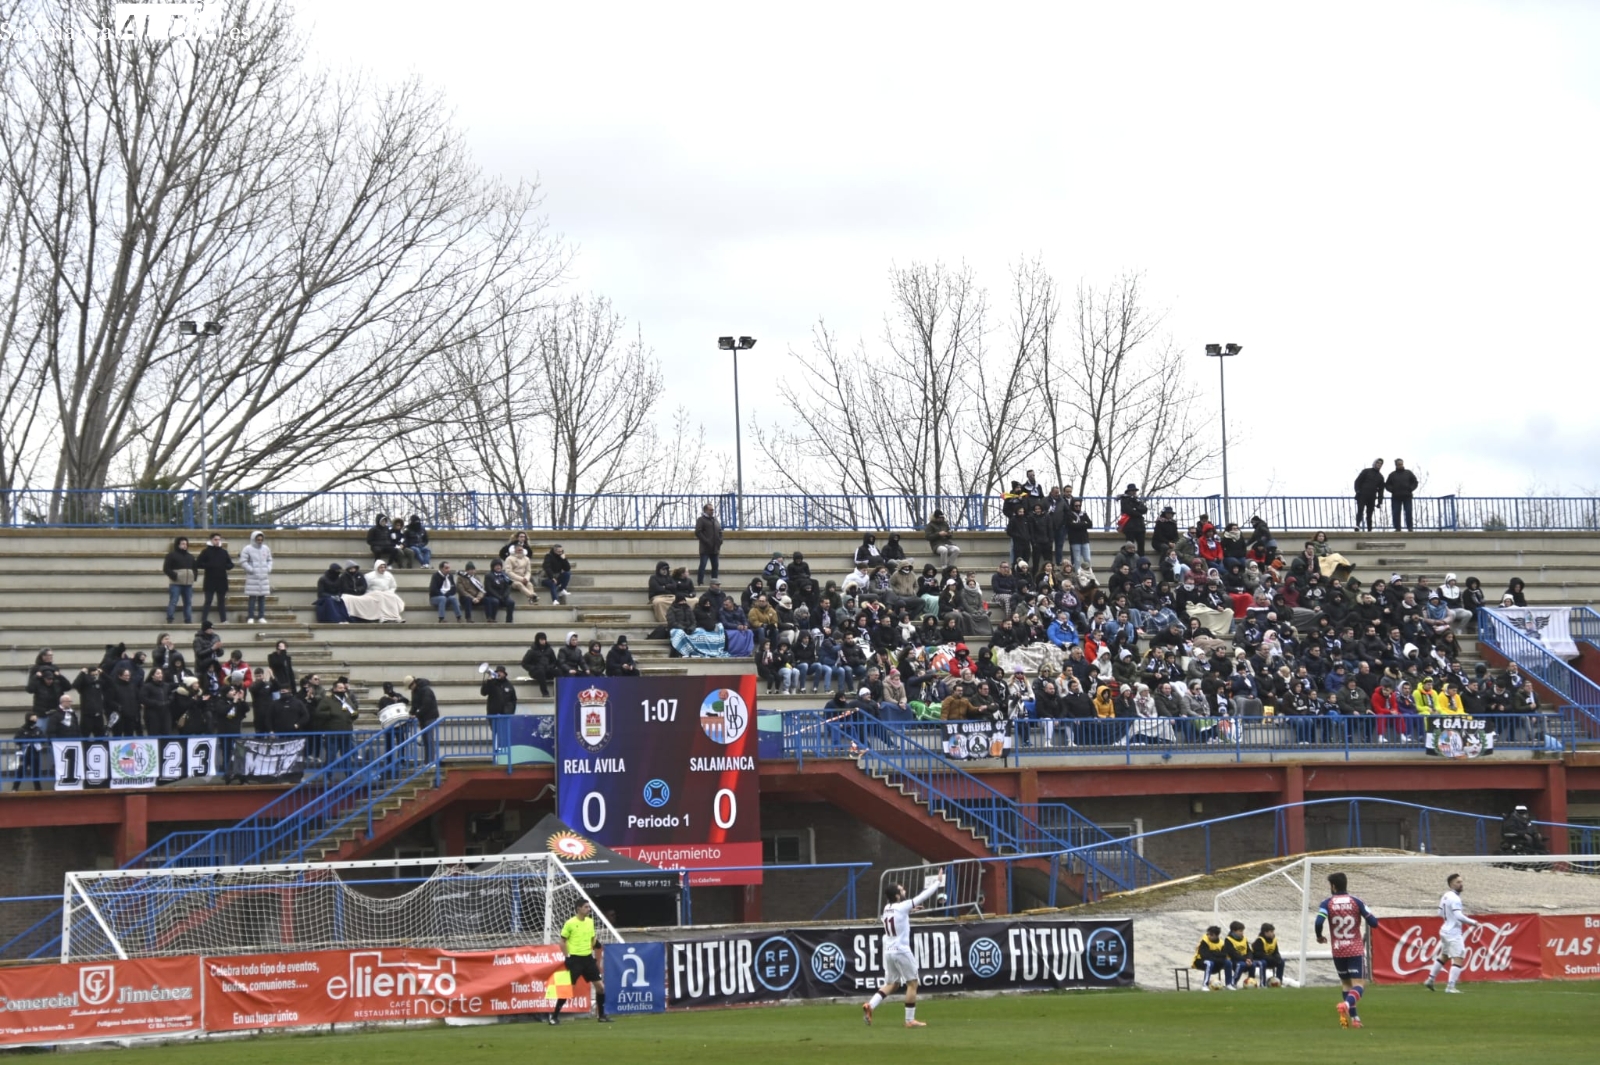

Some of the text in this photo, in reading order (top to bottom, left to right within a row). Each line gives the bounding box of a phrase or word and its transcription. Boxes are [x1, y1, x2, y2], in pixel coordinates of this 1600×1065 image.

[641, 698, 678, 723] 1:07
[946, 719, 1008, 735] BY ORDER OF
[1432, 717, 1486, 730] 4 GATOS
[563, 756, 626, 775] REAL ÁVILA
[689, 755, 755, 772] SALAMANCA
[582, 791, 607, 833] 0
[713, 788, 737, 830] 0
[627, 813, 690, 829] Periodo 1
[637, 848, 721, 863] Ayuntamiento
[884, 916, 897, 937] 11
[1331, 915, 1356, 939] 22
[493, 954, 514, 966] Avda.
[515, 953, 524, 964] de
[523, 952, 553, 965] Madrid,
[853, 931, 963, 972] SENDA
[1008, 927, 1085, 982] FUTUR
[210, 960, 320, 977] Celebra todo tipo de eventos,
[672, 938, 756, 999] FUTUR
[116, 985, 193, 1005] Jiménez
[222, 980, 249, 993] bodas,
[511, 982, 530, 994] Tfno:
[531, 980, 544, 993] 920
[0, 992, 80, 1013] Comercial
[389, 999, 412, 1009] CAFÉ
[413, 993, 483, 1015] norte
[490, 998, 510, 1011] Tfno.
[510, 996, 549, 1010] Comercial:
[617, 989, 653, 1003] ÁVILA
[233, 1009, 299, 1026] En un lugar único
[354, 1008, 412, 1018] RESTAURANTE
